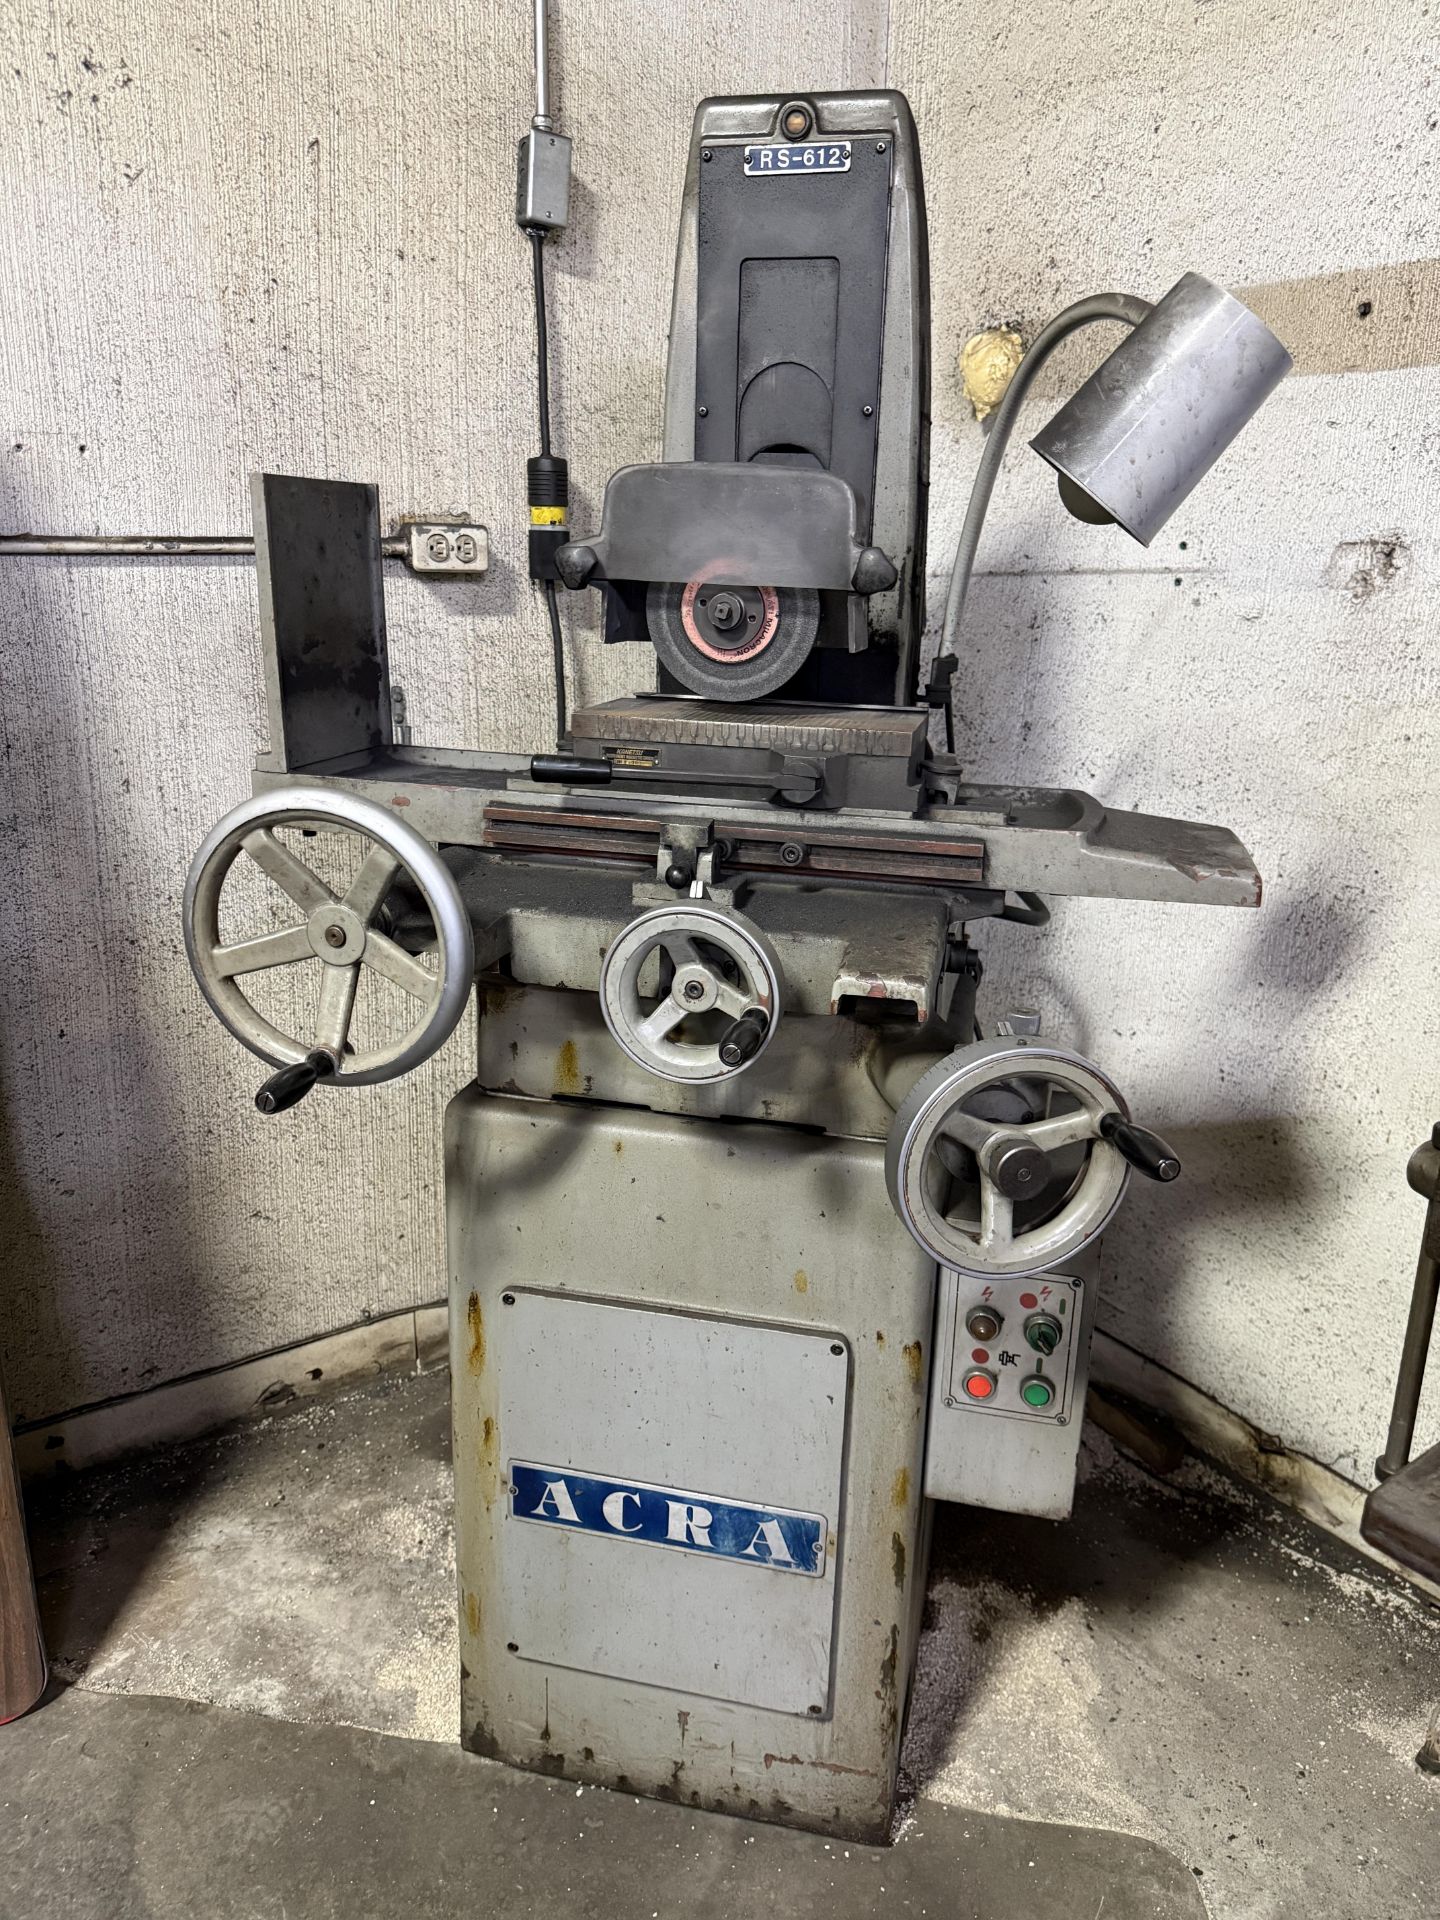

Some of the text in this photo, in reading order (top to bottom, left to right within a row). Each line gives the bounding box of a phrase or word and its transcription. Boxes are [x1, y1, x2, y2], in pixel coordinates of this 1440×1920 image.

[760, 148, 840, 169] RS-612
[735, 618, 773, 656] MILACRON
[530, 1479, 798, 1563] ACRA
